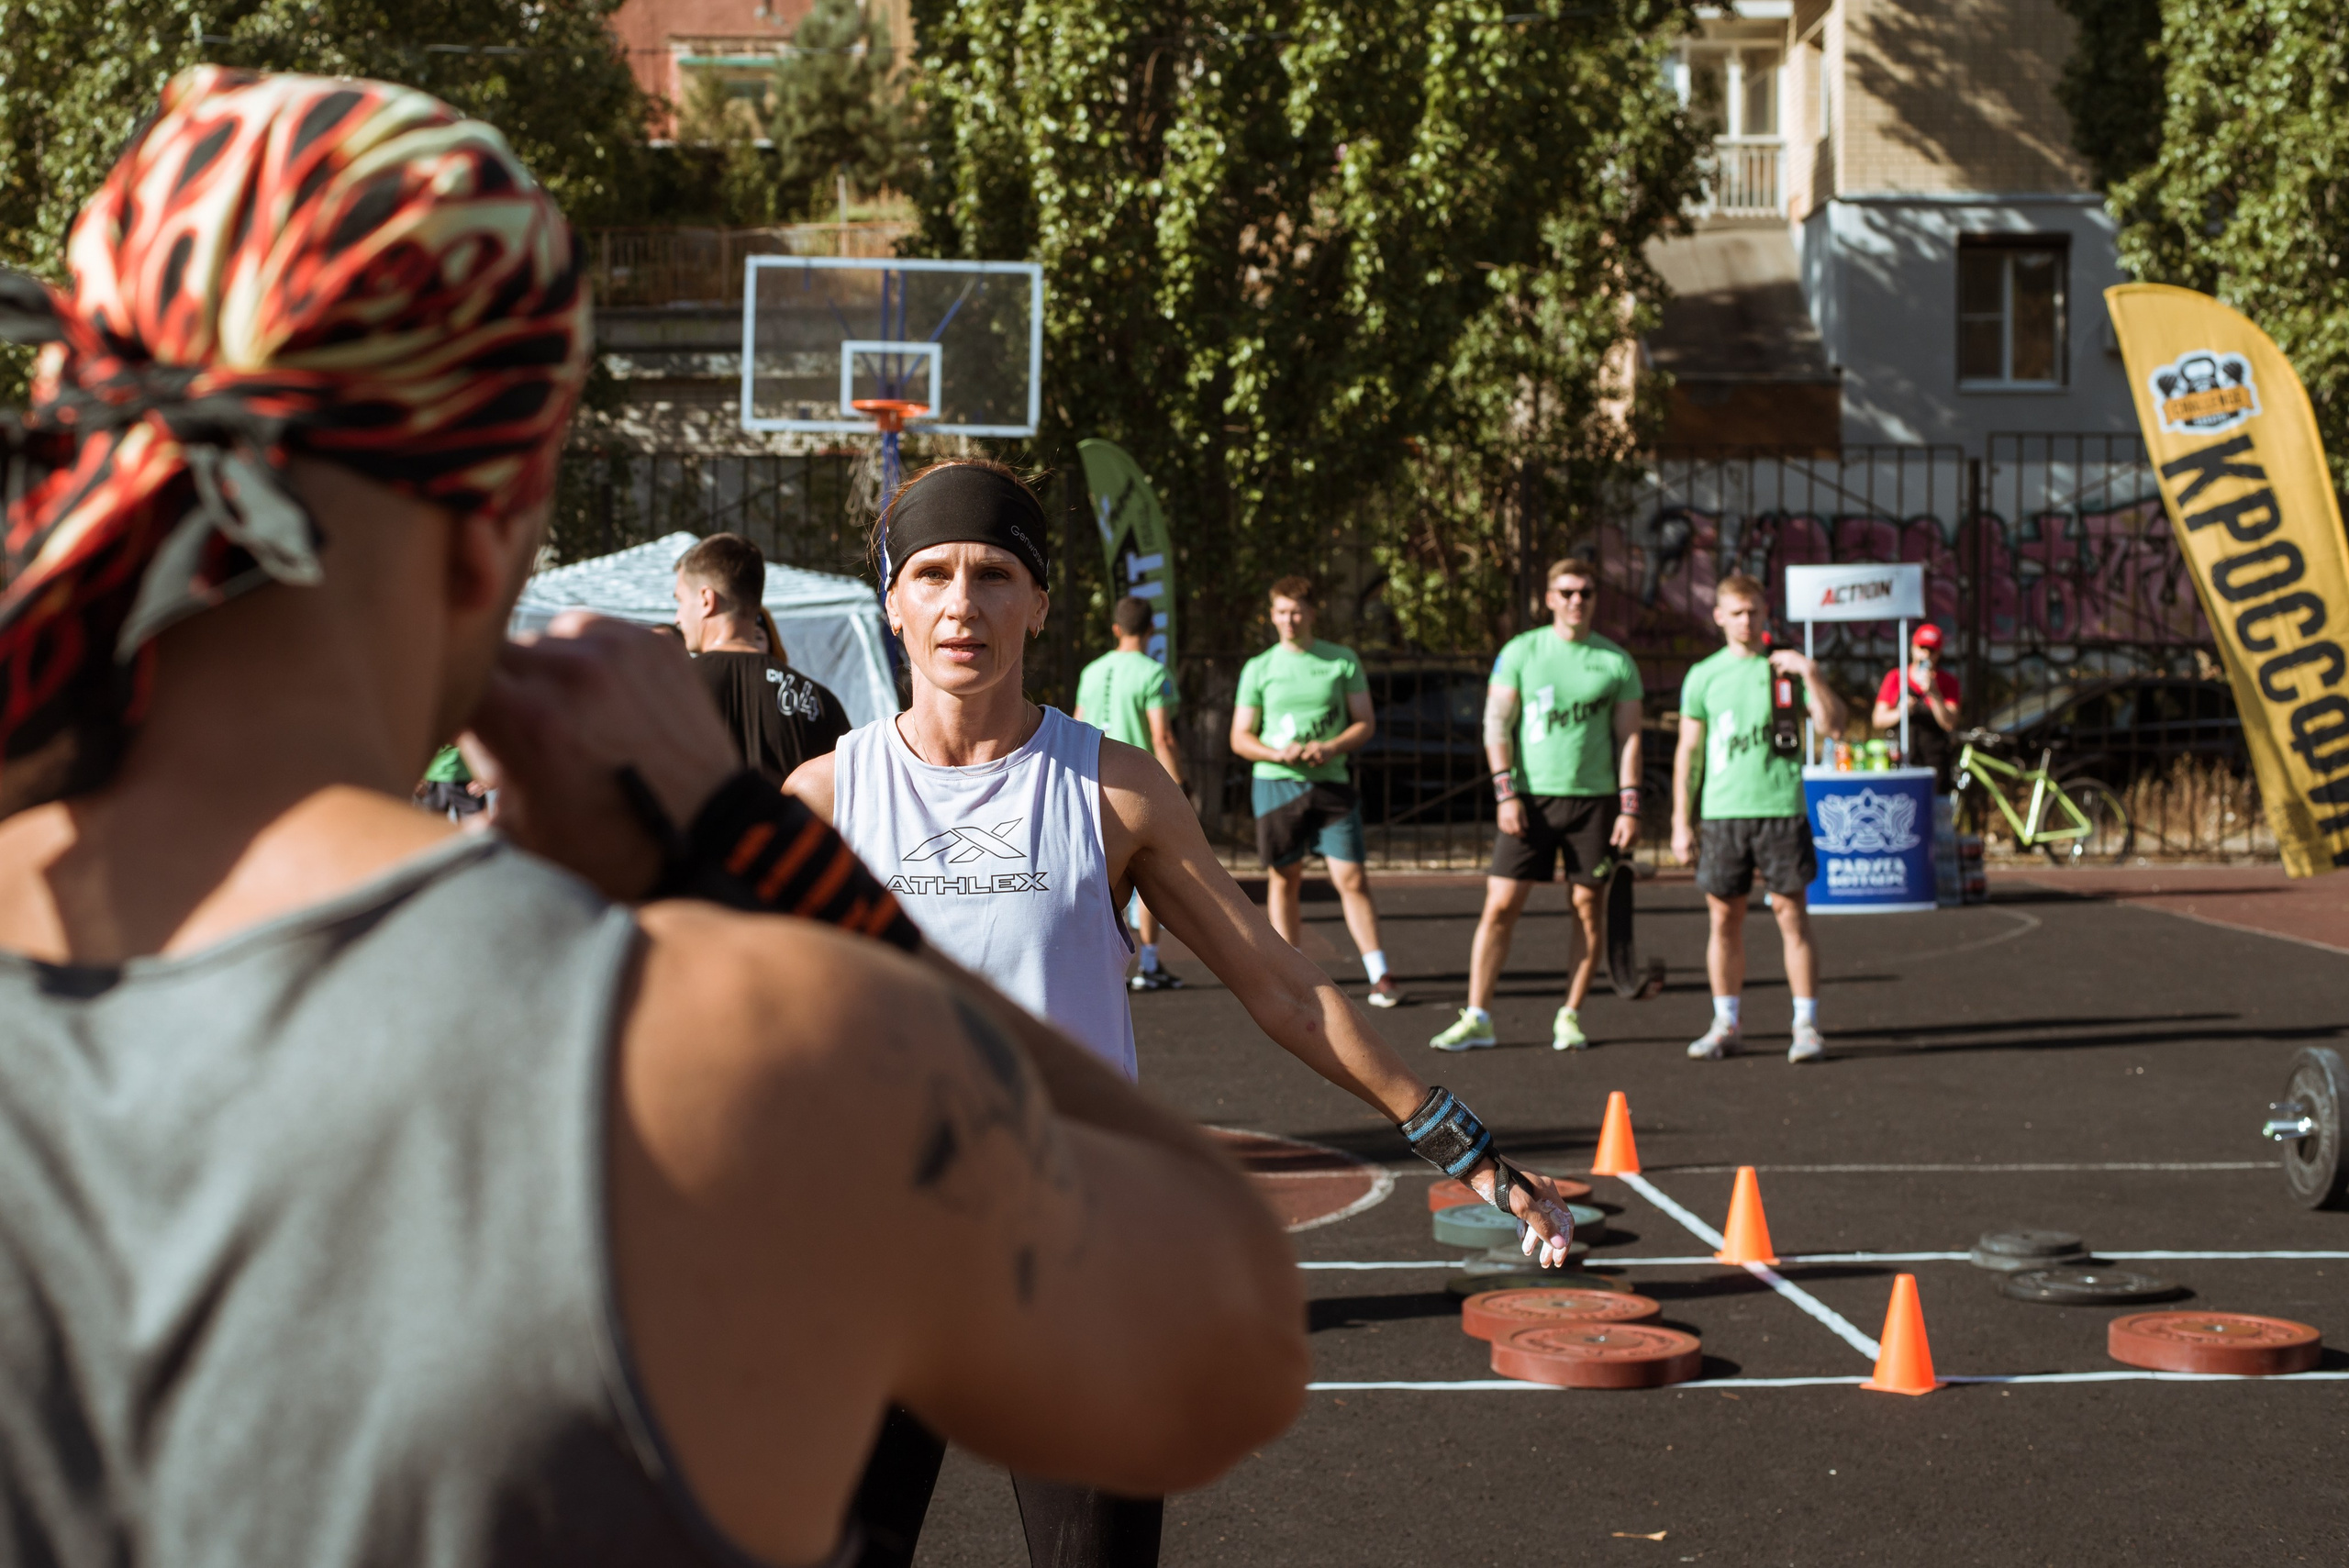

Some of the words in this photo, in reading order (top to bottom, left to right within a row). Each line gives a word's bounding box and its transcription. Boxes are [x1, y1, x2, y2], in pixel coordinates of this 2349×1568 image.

[1820, 579, 1893, 607] ACTION
[2162, 433, 2349, 867] КРОССФ
[777, 673, 819, 722] 64
[885, 872, 1050, 895] ATHLEX
